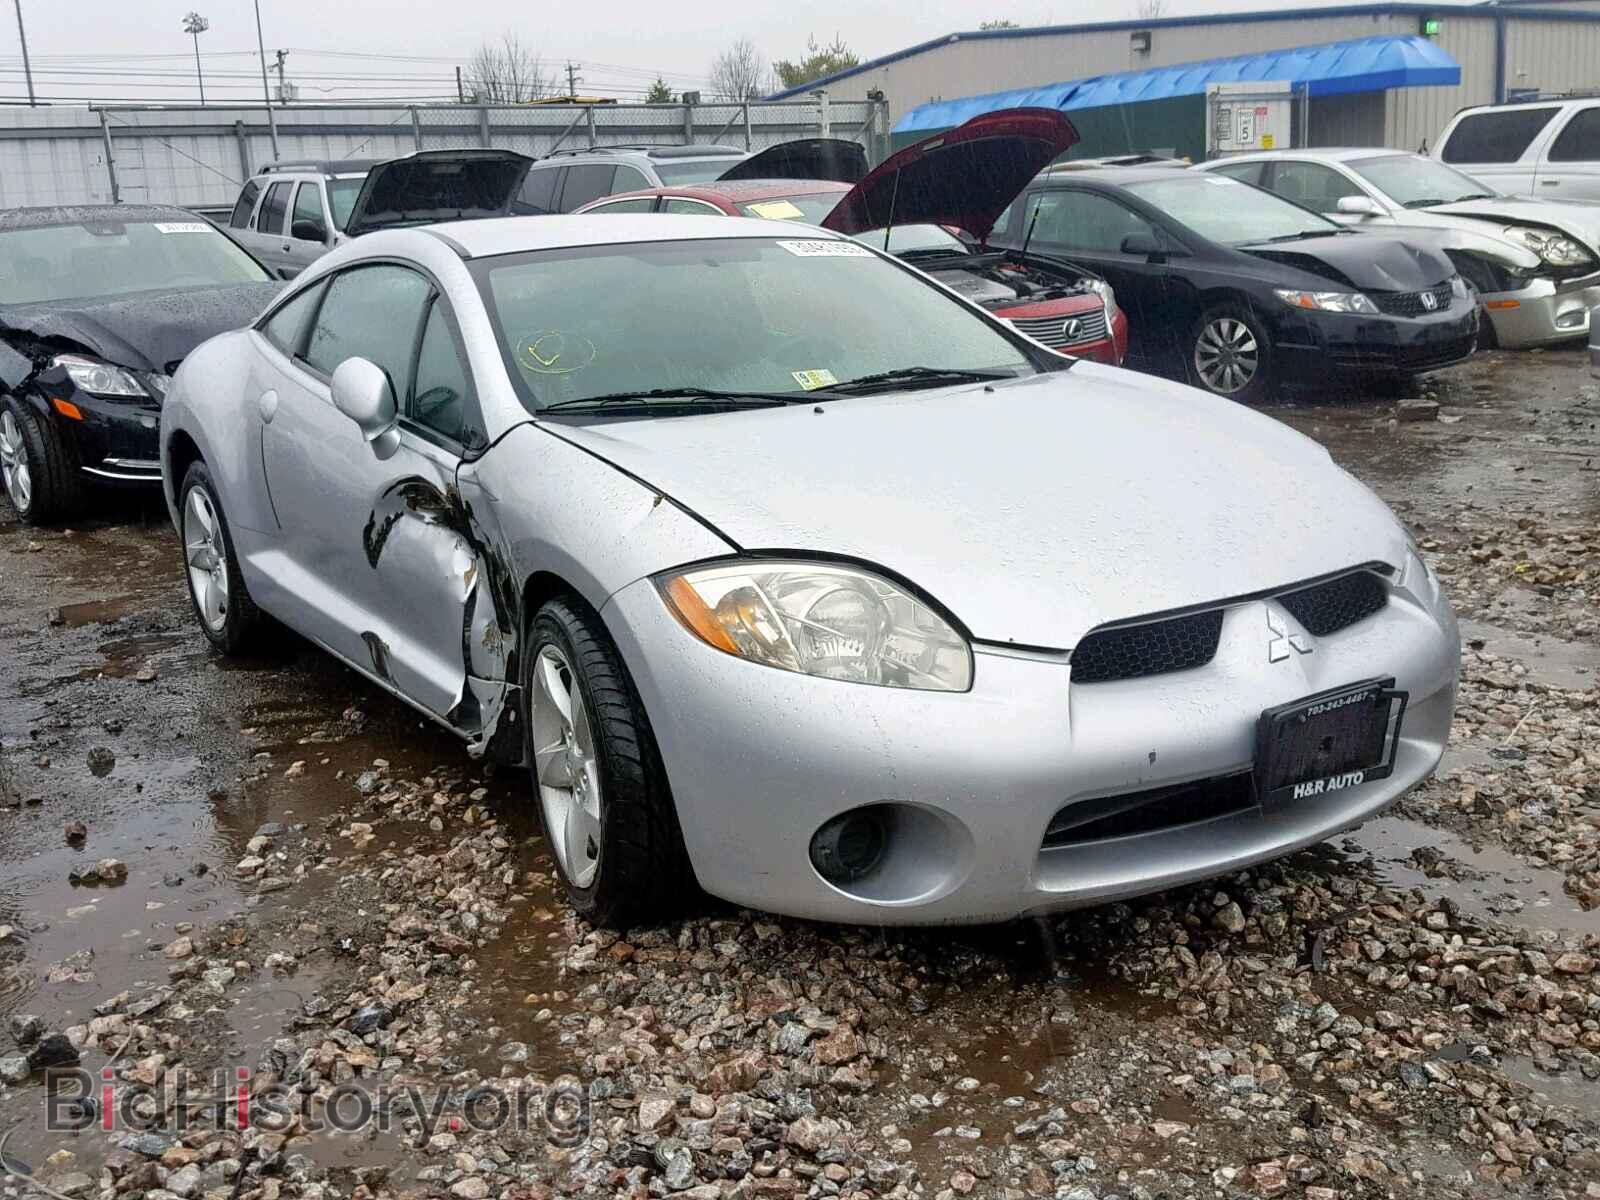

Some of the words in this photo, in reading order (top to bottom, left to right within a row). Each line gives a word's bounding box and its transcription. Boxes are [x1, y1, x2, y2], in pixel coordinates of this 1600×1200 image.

[1241, 127, 1249, 140] 5
[1294, 780, 1325, 799] H&R
[1326, 772, 1364, 792] AUTO
